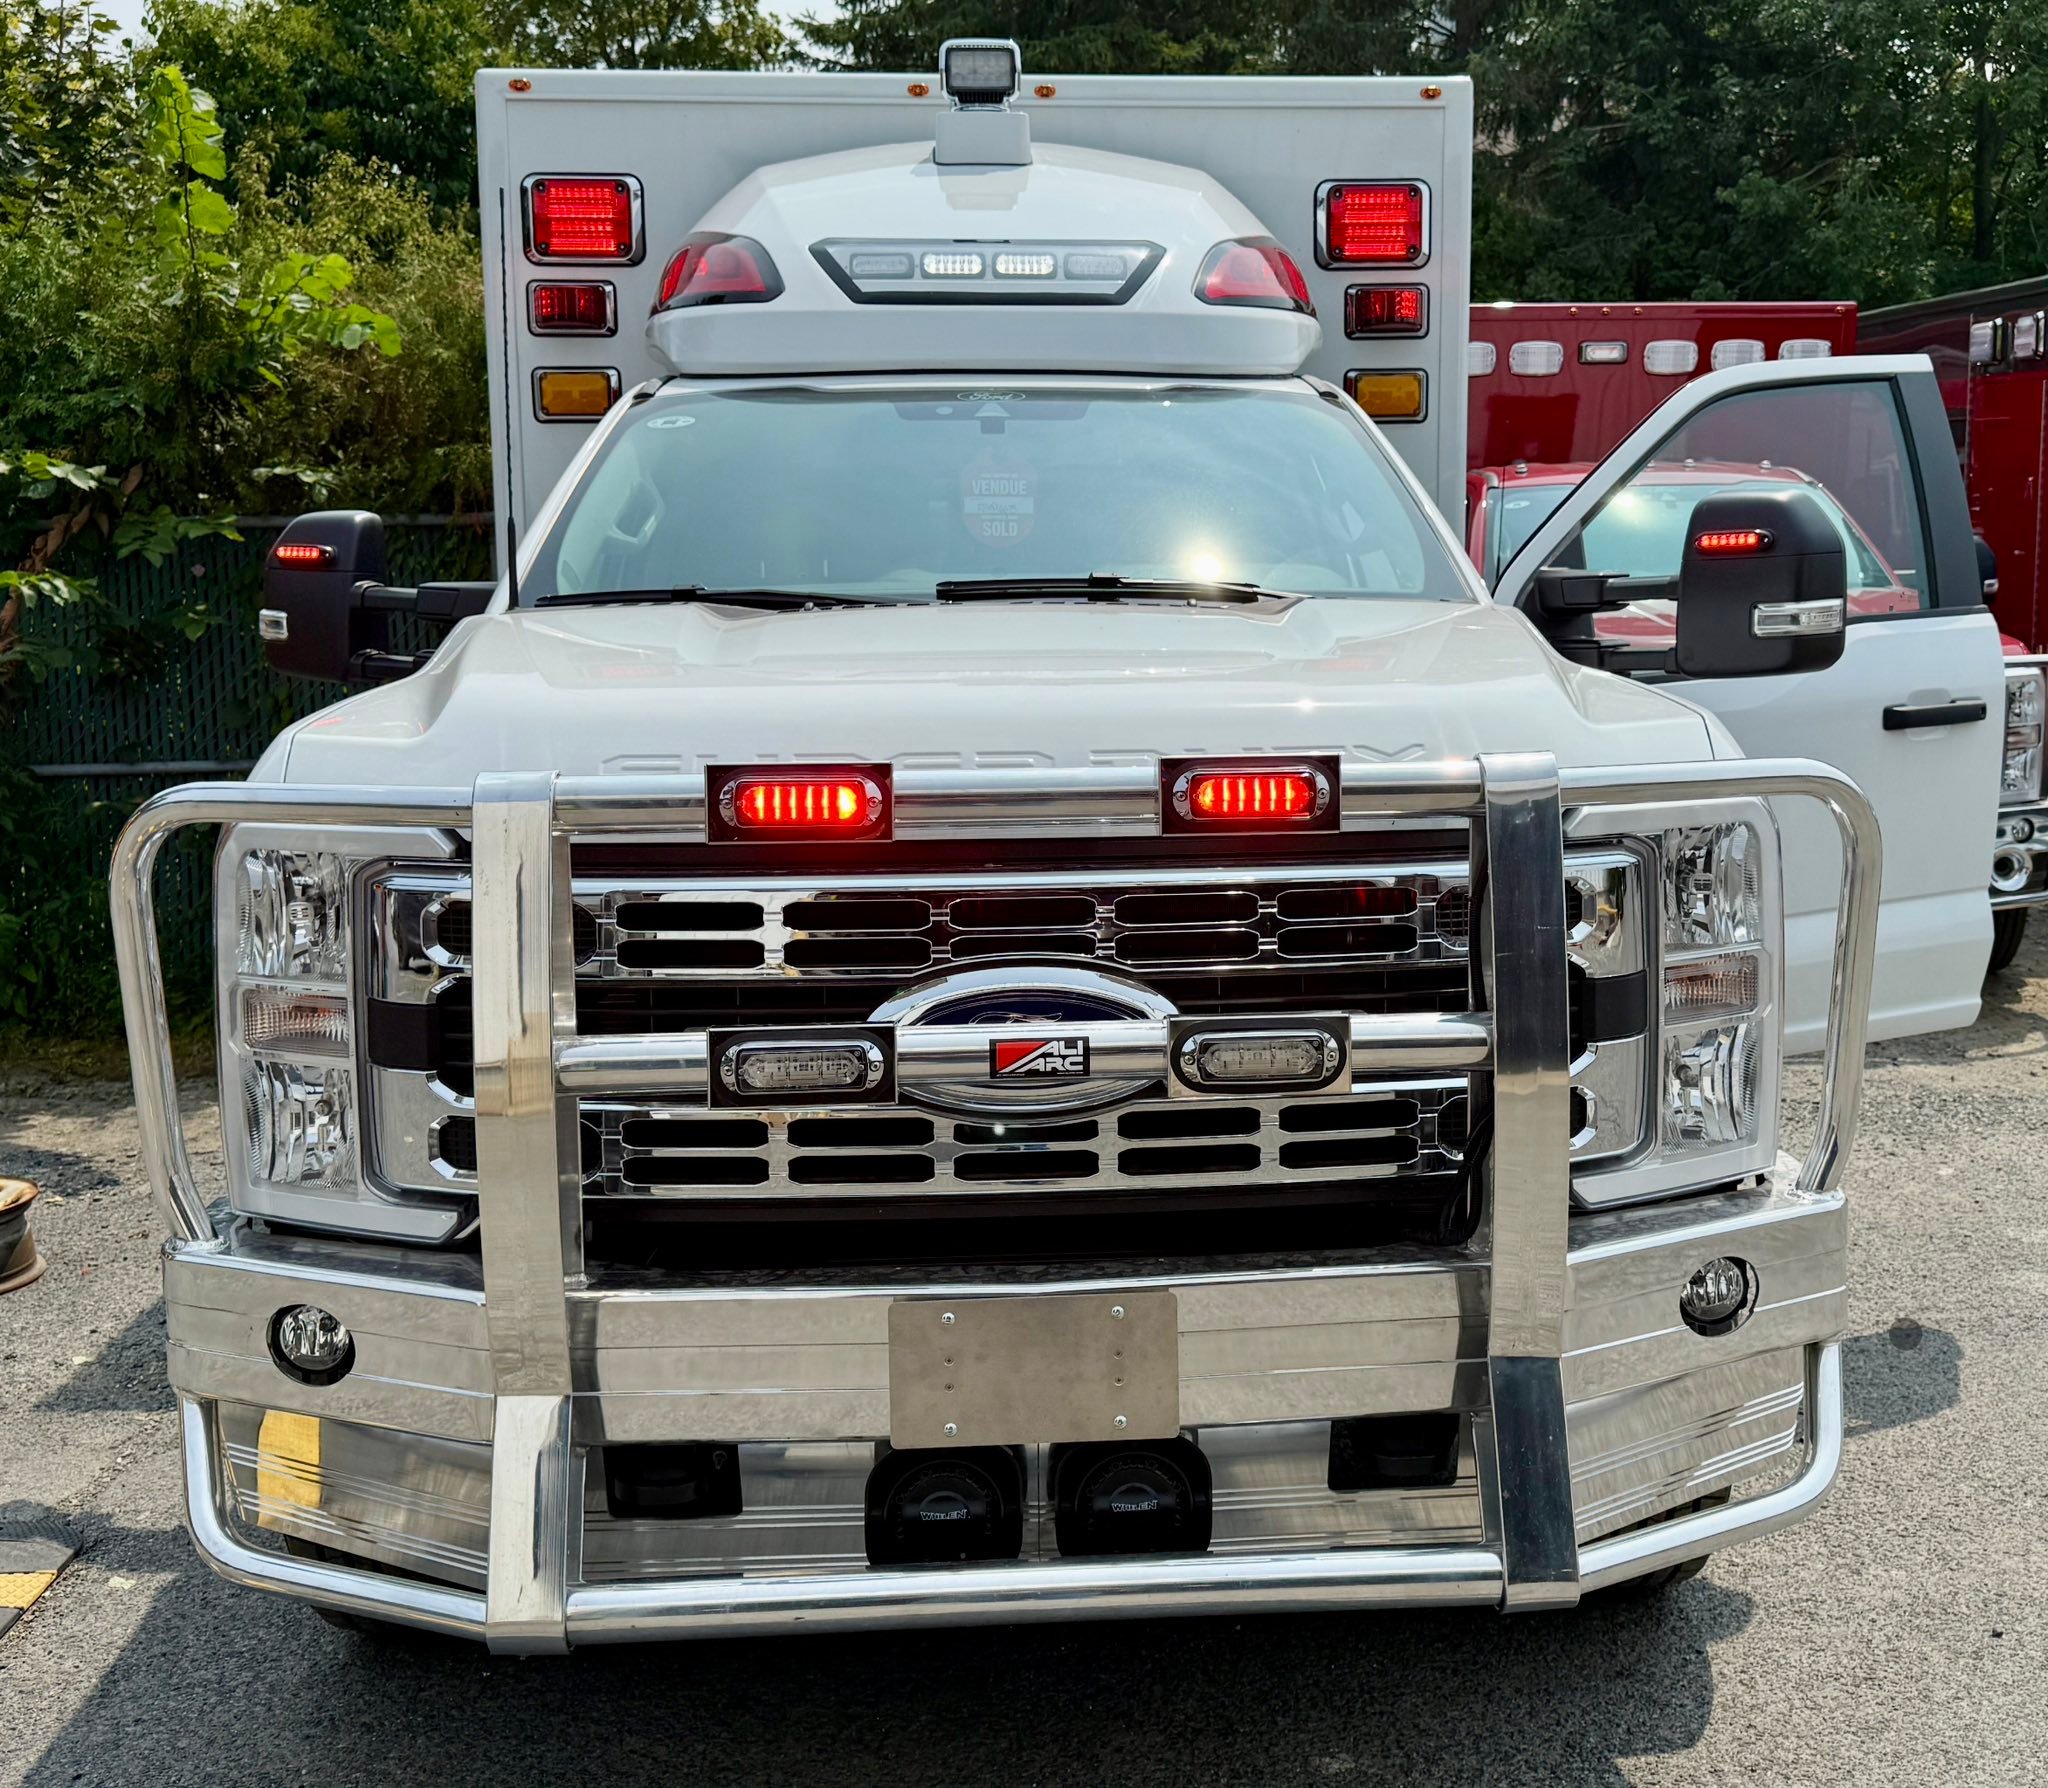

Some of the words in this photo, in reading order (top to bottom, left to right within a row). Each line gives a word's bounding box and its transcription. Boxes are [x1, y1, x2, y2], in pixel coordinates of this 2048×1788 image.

[972, 480, 1027, 495] VENDUE
[982, 521, 1018, 537] SOLD
[1016, 1056, 1084, 1072] ARC
[1111, 1500, 1158, 1512] WHELEN
[920, 1509, 968, 1520] WHELEN
